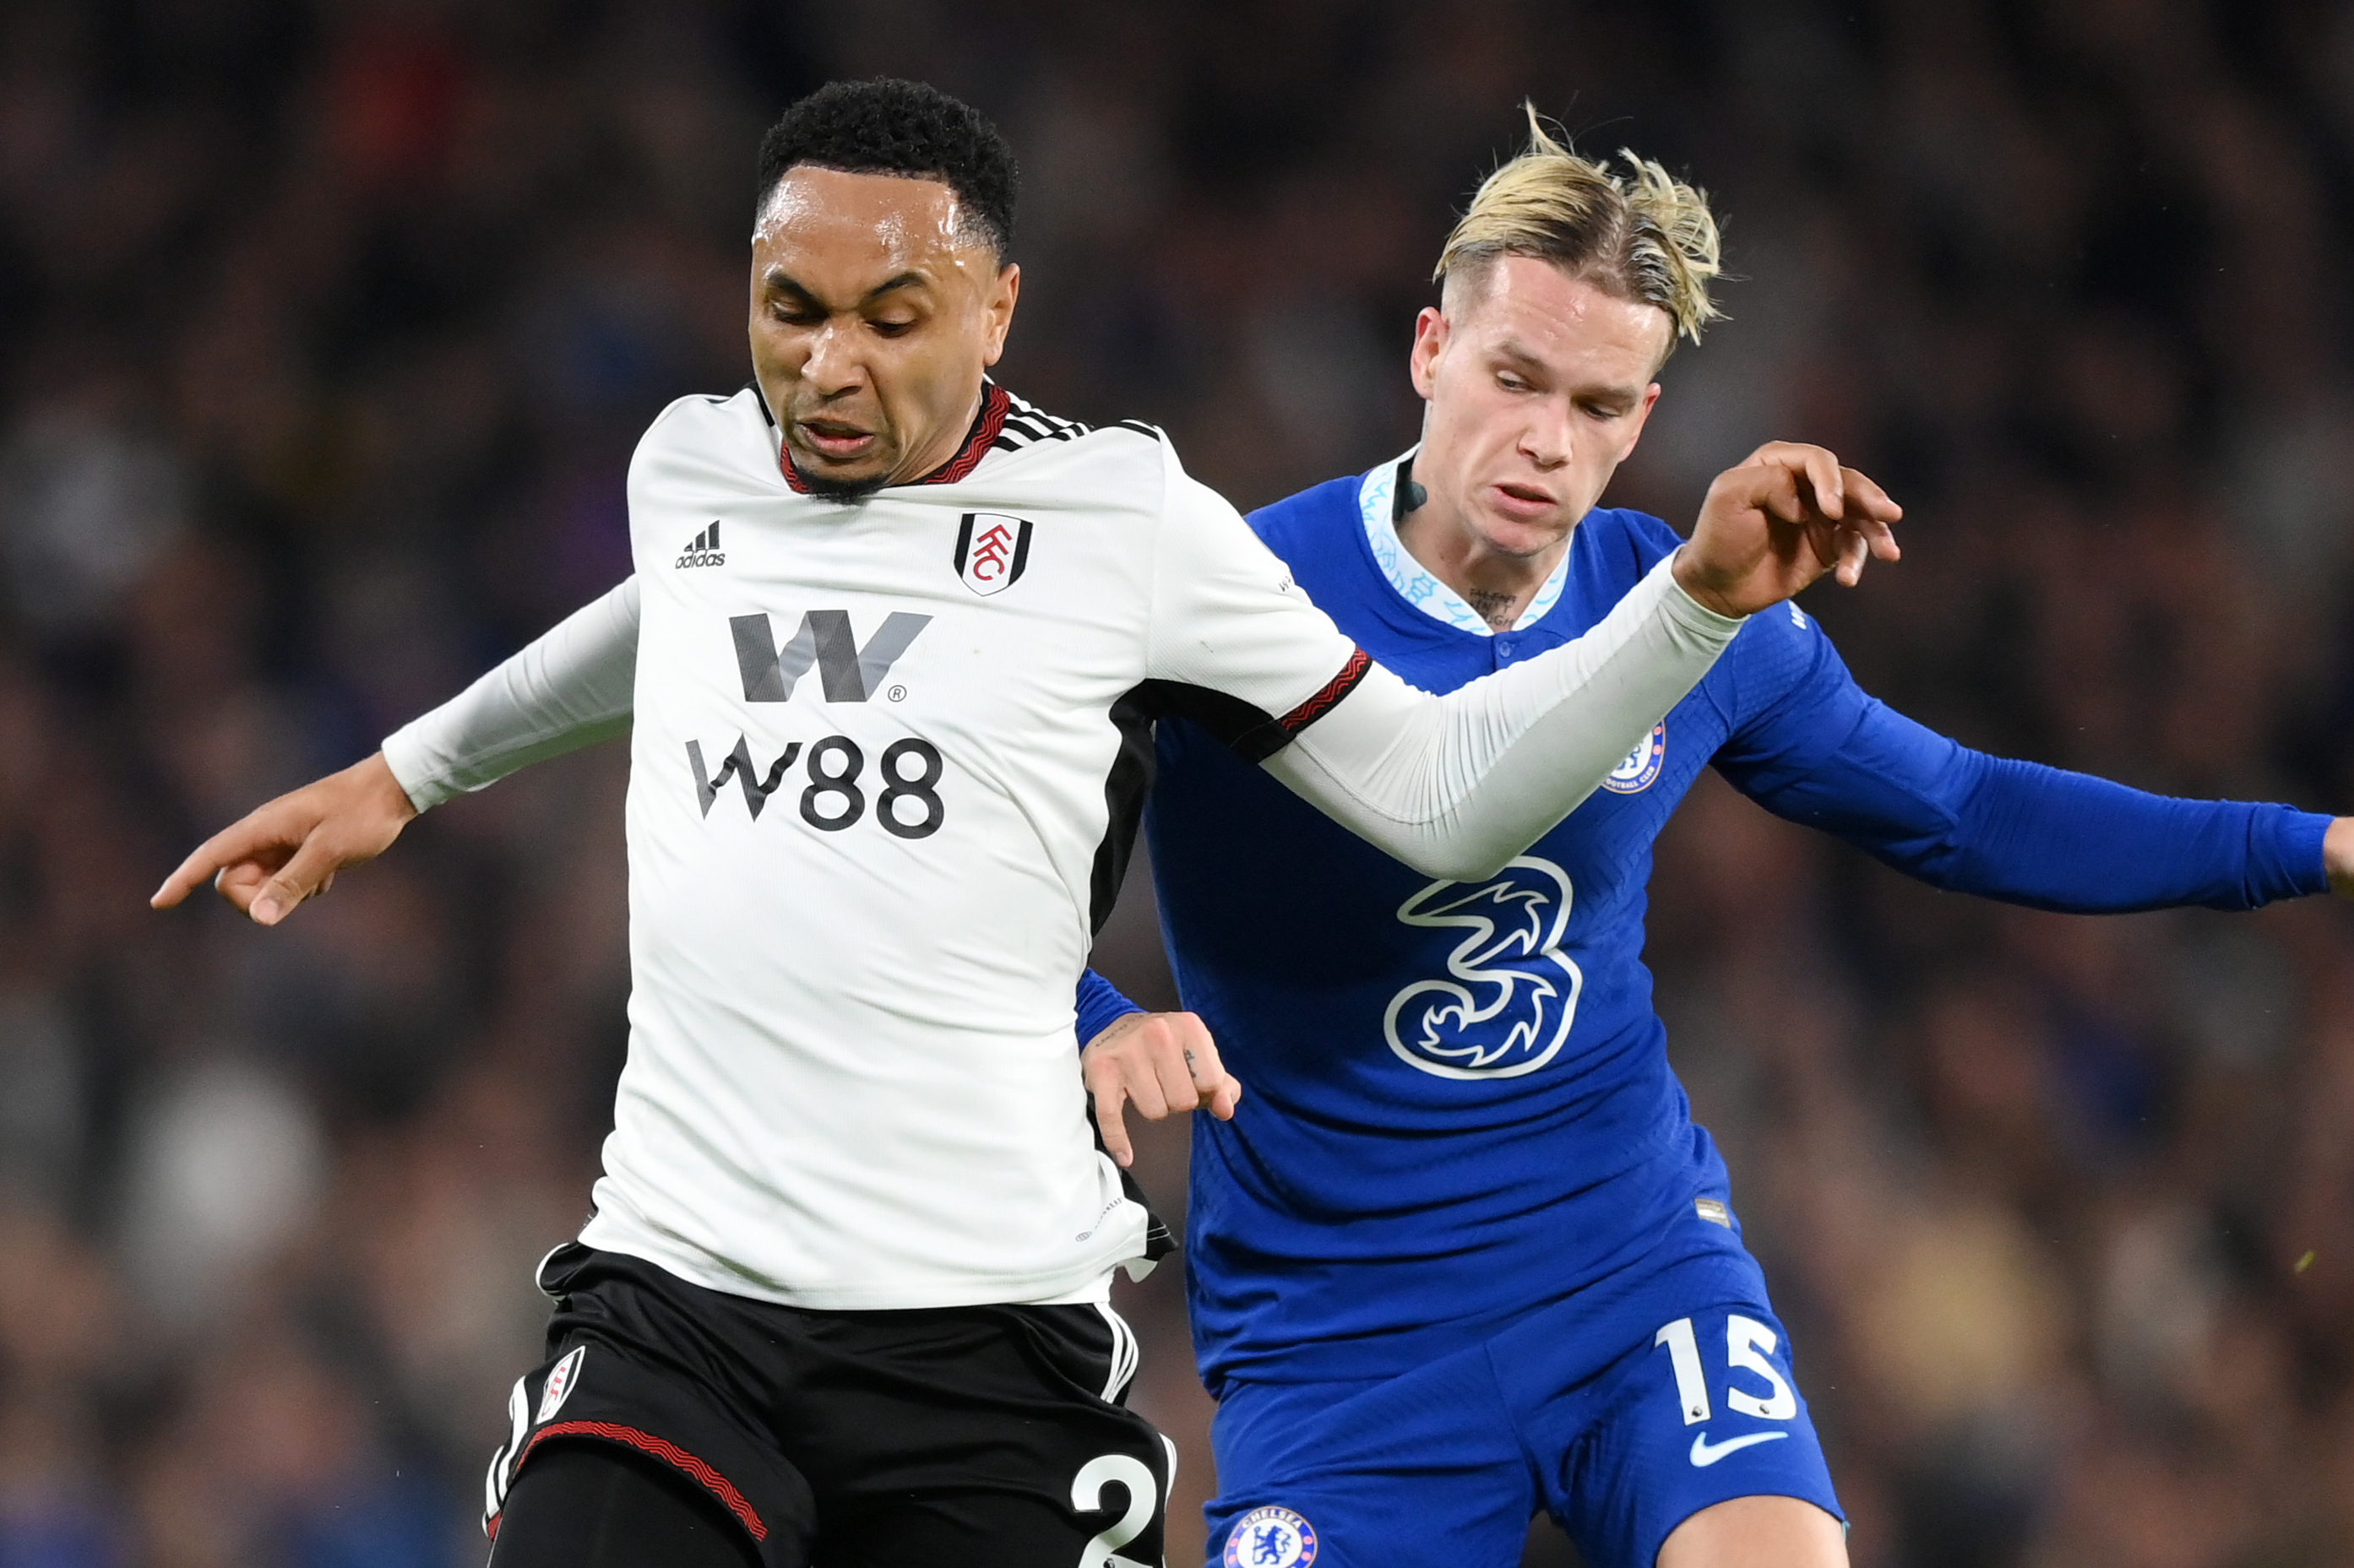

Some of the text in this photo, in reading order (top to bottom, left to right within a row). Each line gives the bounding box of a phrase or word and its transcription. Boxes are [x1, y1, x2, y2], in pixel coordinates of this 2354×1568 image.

[675, 549, 726, 569] adidas
[973, 524, 1013, 581] FFC
[685, 732, 944, 839] W88
[1605, 777, 1639, 789] OOTBALL
[1655, 1314, 1797, 1426] 15
[1071, 1454, 1157, 1568] 2
[1242, 1509, 1303, 1529] CHELSEA
